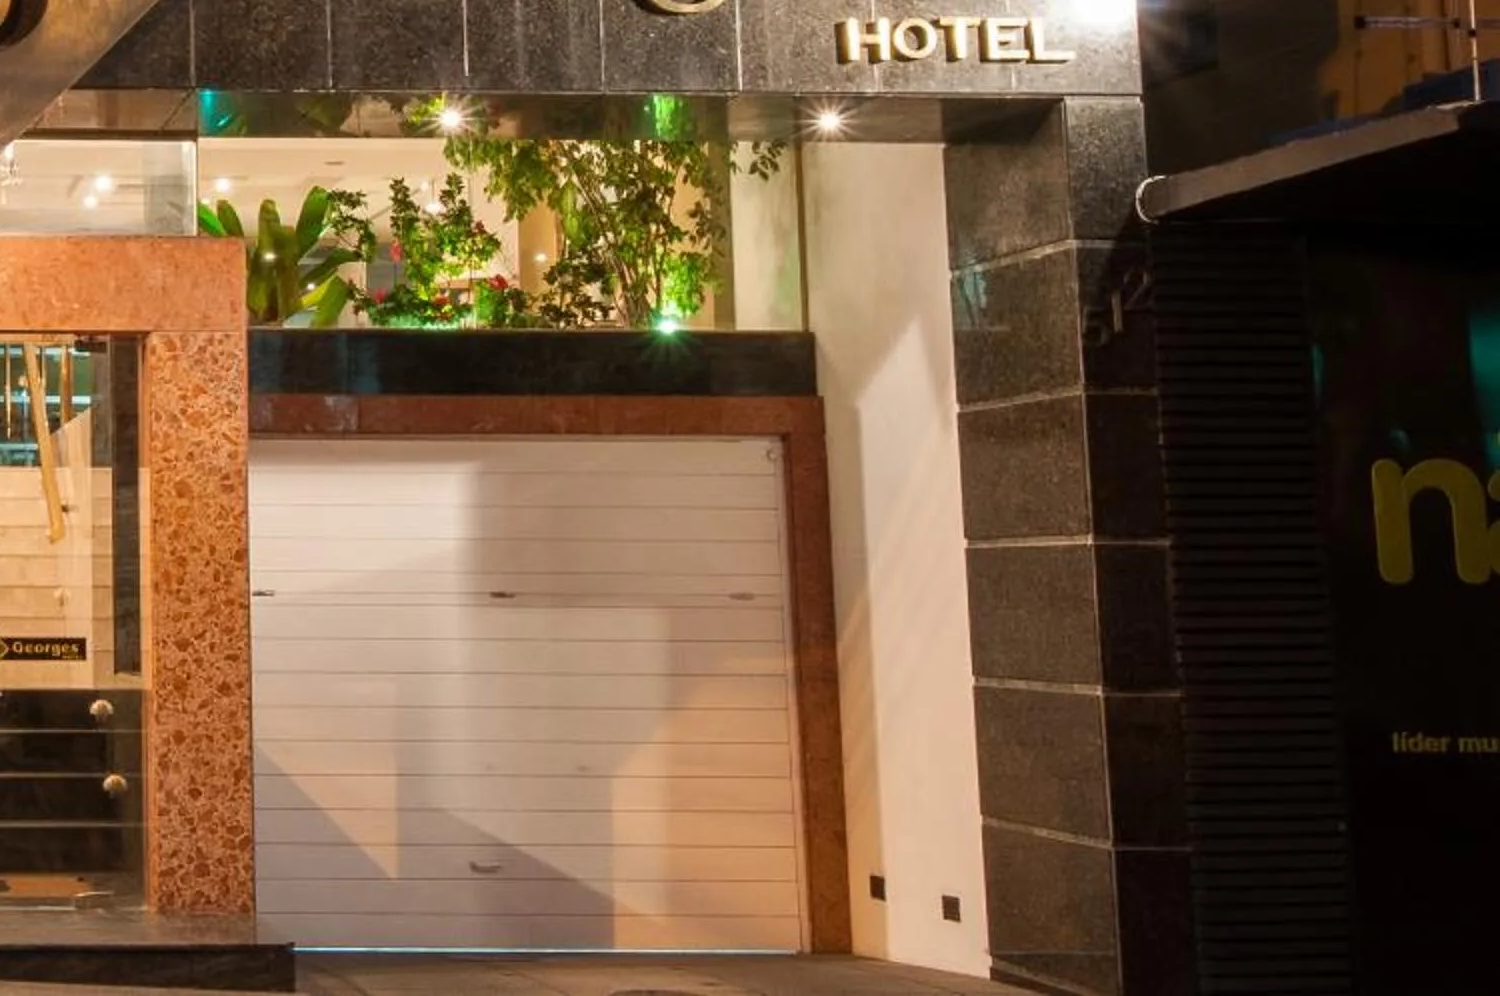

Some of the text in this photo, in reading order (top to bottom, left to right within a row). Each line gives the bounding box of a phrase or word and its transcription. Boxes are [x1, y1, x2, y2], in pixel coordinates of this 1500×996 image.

[841, 16, 1077, 64] HOTEL
[12, 641, 80, 657] Georges
[1392, 731, 1450, 753] líder
